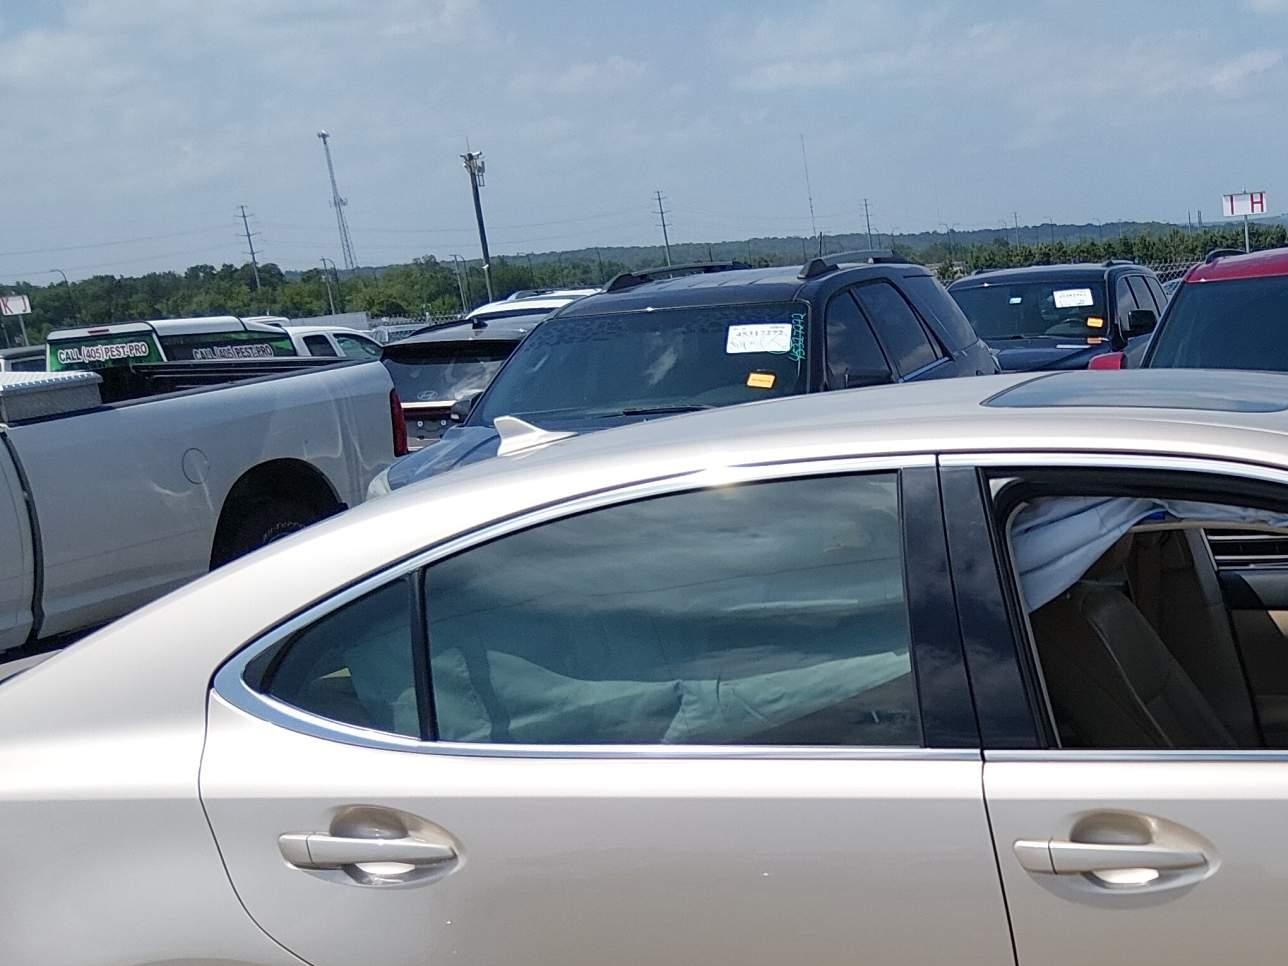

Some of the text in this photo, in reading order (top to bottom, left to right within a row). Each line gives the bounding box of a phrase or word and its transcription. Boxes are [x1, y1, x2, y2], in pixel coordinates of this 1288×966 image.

[1250, 192, 1264, 213] H
[1, 295, 28, 314] K J
[58, 342, 149, 363] CALL (405) PEST-PRO
